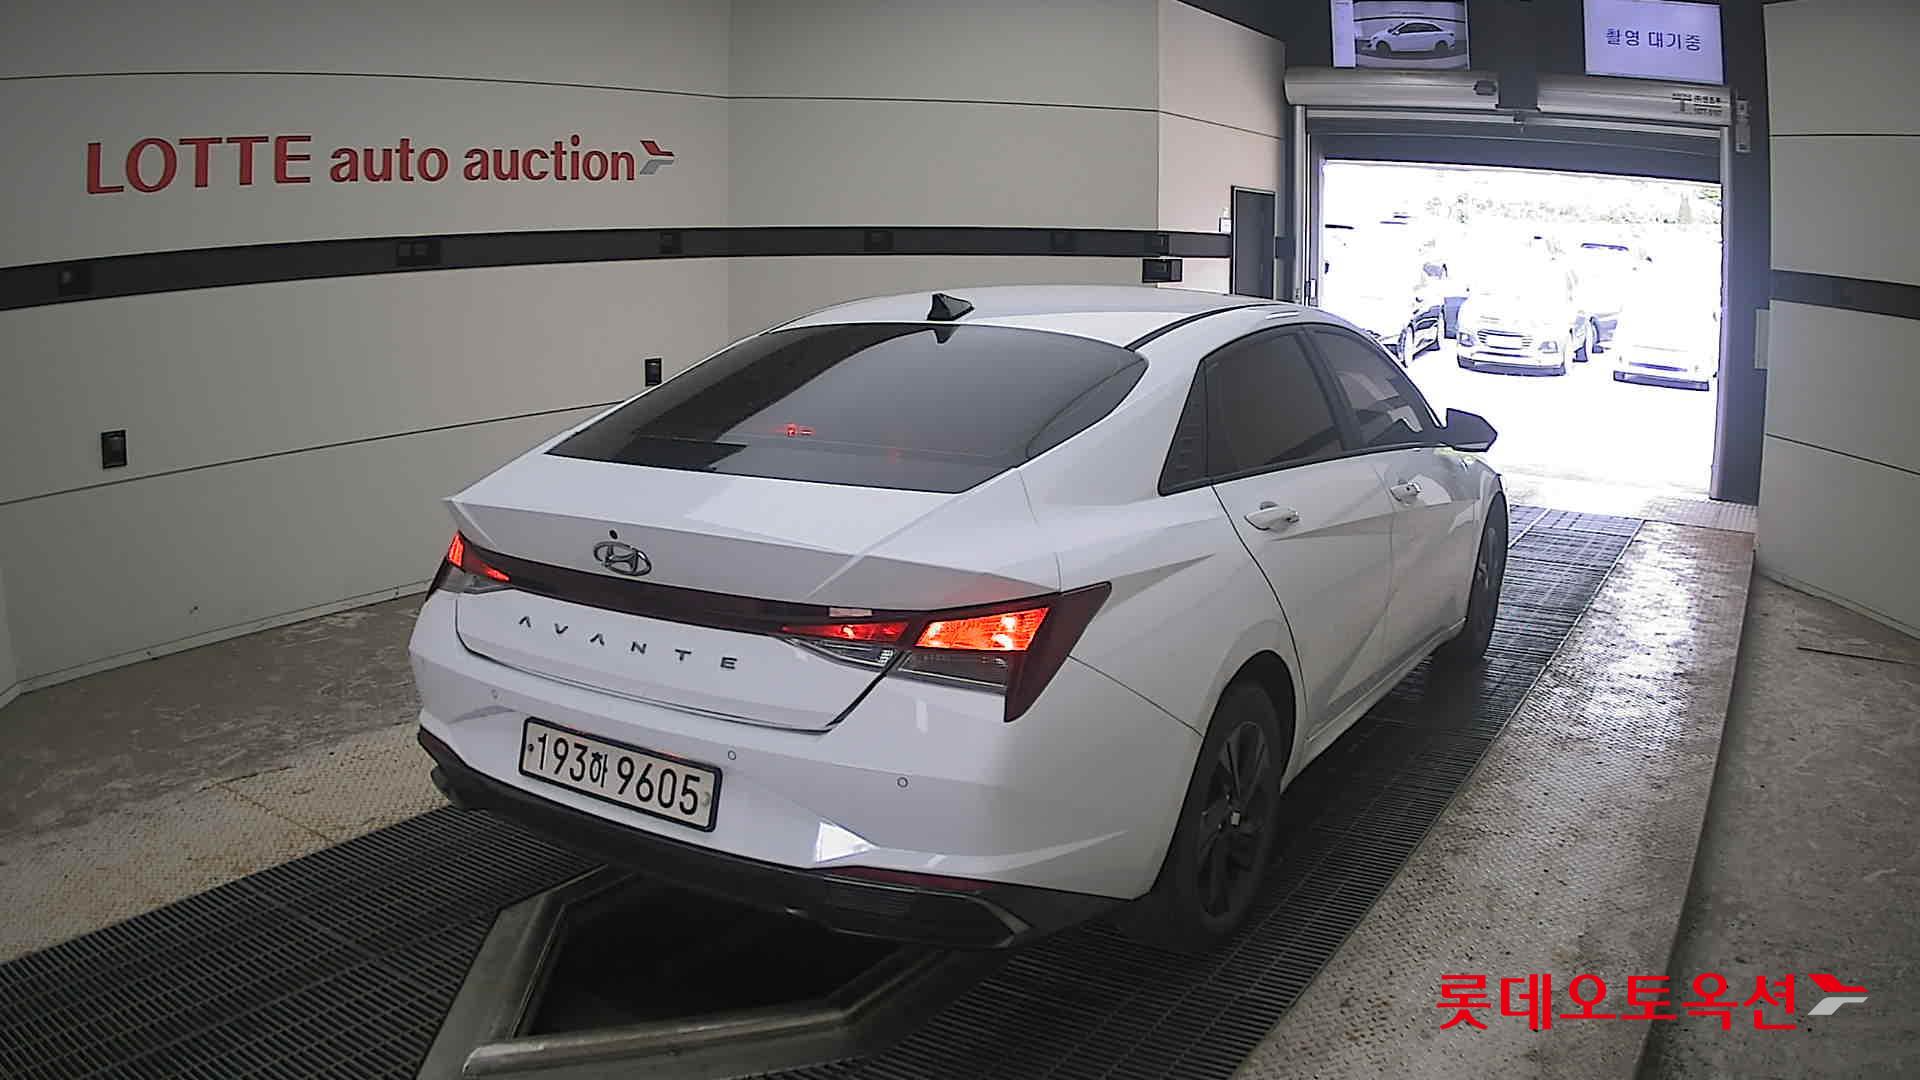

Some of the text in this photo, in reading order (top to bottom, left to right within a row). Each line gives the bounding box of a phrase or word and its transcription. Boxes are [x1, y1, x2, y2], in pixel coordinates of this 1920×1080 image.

[1648, 31, 1701, 52] 대기중
[88, 132, 636, 193] LOTTE auto auction
[518, 615, 738, 670] AVANTE
[537, 733, 701, 815] 193하 9605
